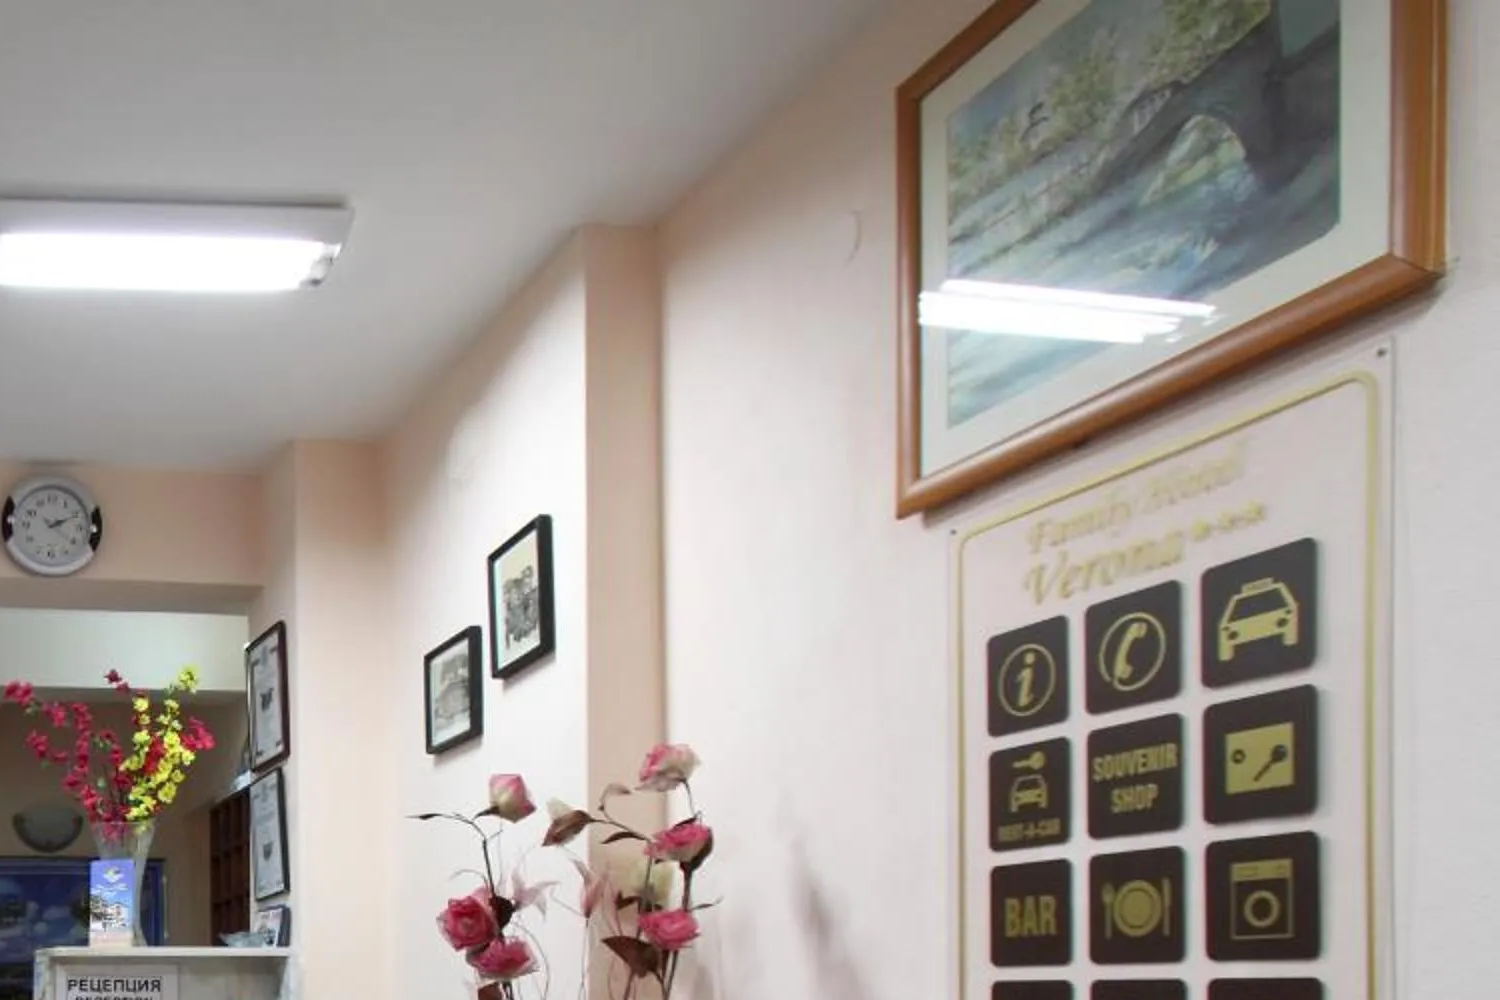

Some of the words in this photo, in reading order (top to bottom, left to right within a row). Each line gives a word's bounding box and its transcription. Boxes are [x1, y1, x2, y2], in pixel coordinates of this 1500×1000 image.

[1023, 530, 1183, 605] Verona
[1092, 743, 1178, 782] SOUVENIR
[1111, 784, 1160, 814] SHOP
[1005, 895, 1058, 938] BAR
[67, 978, 162, 994] РЕЦЕПЦИЯ
